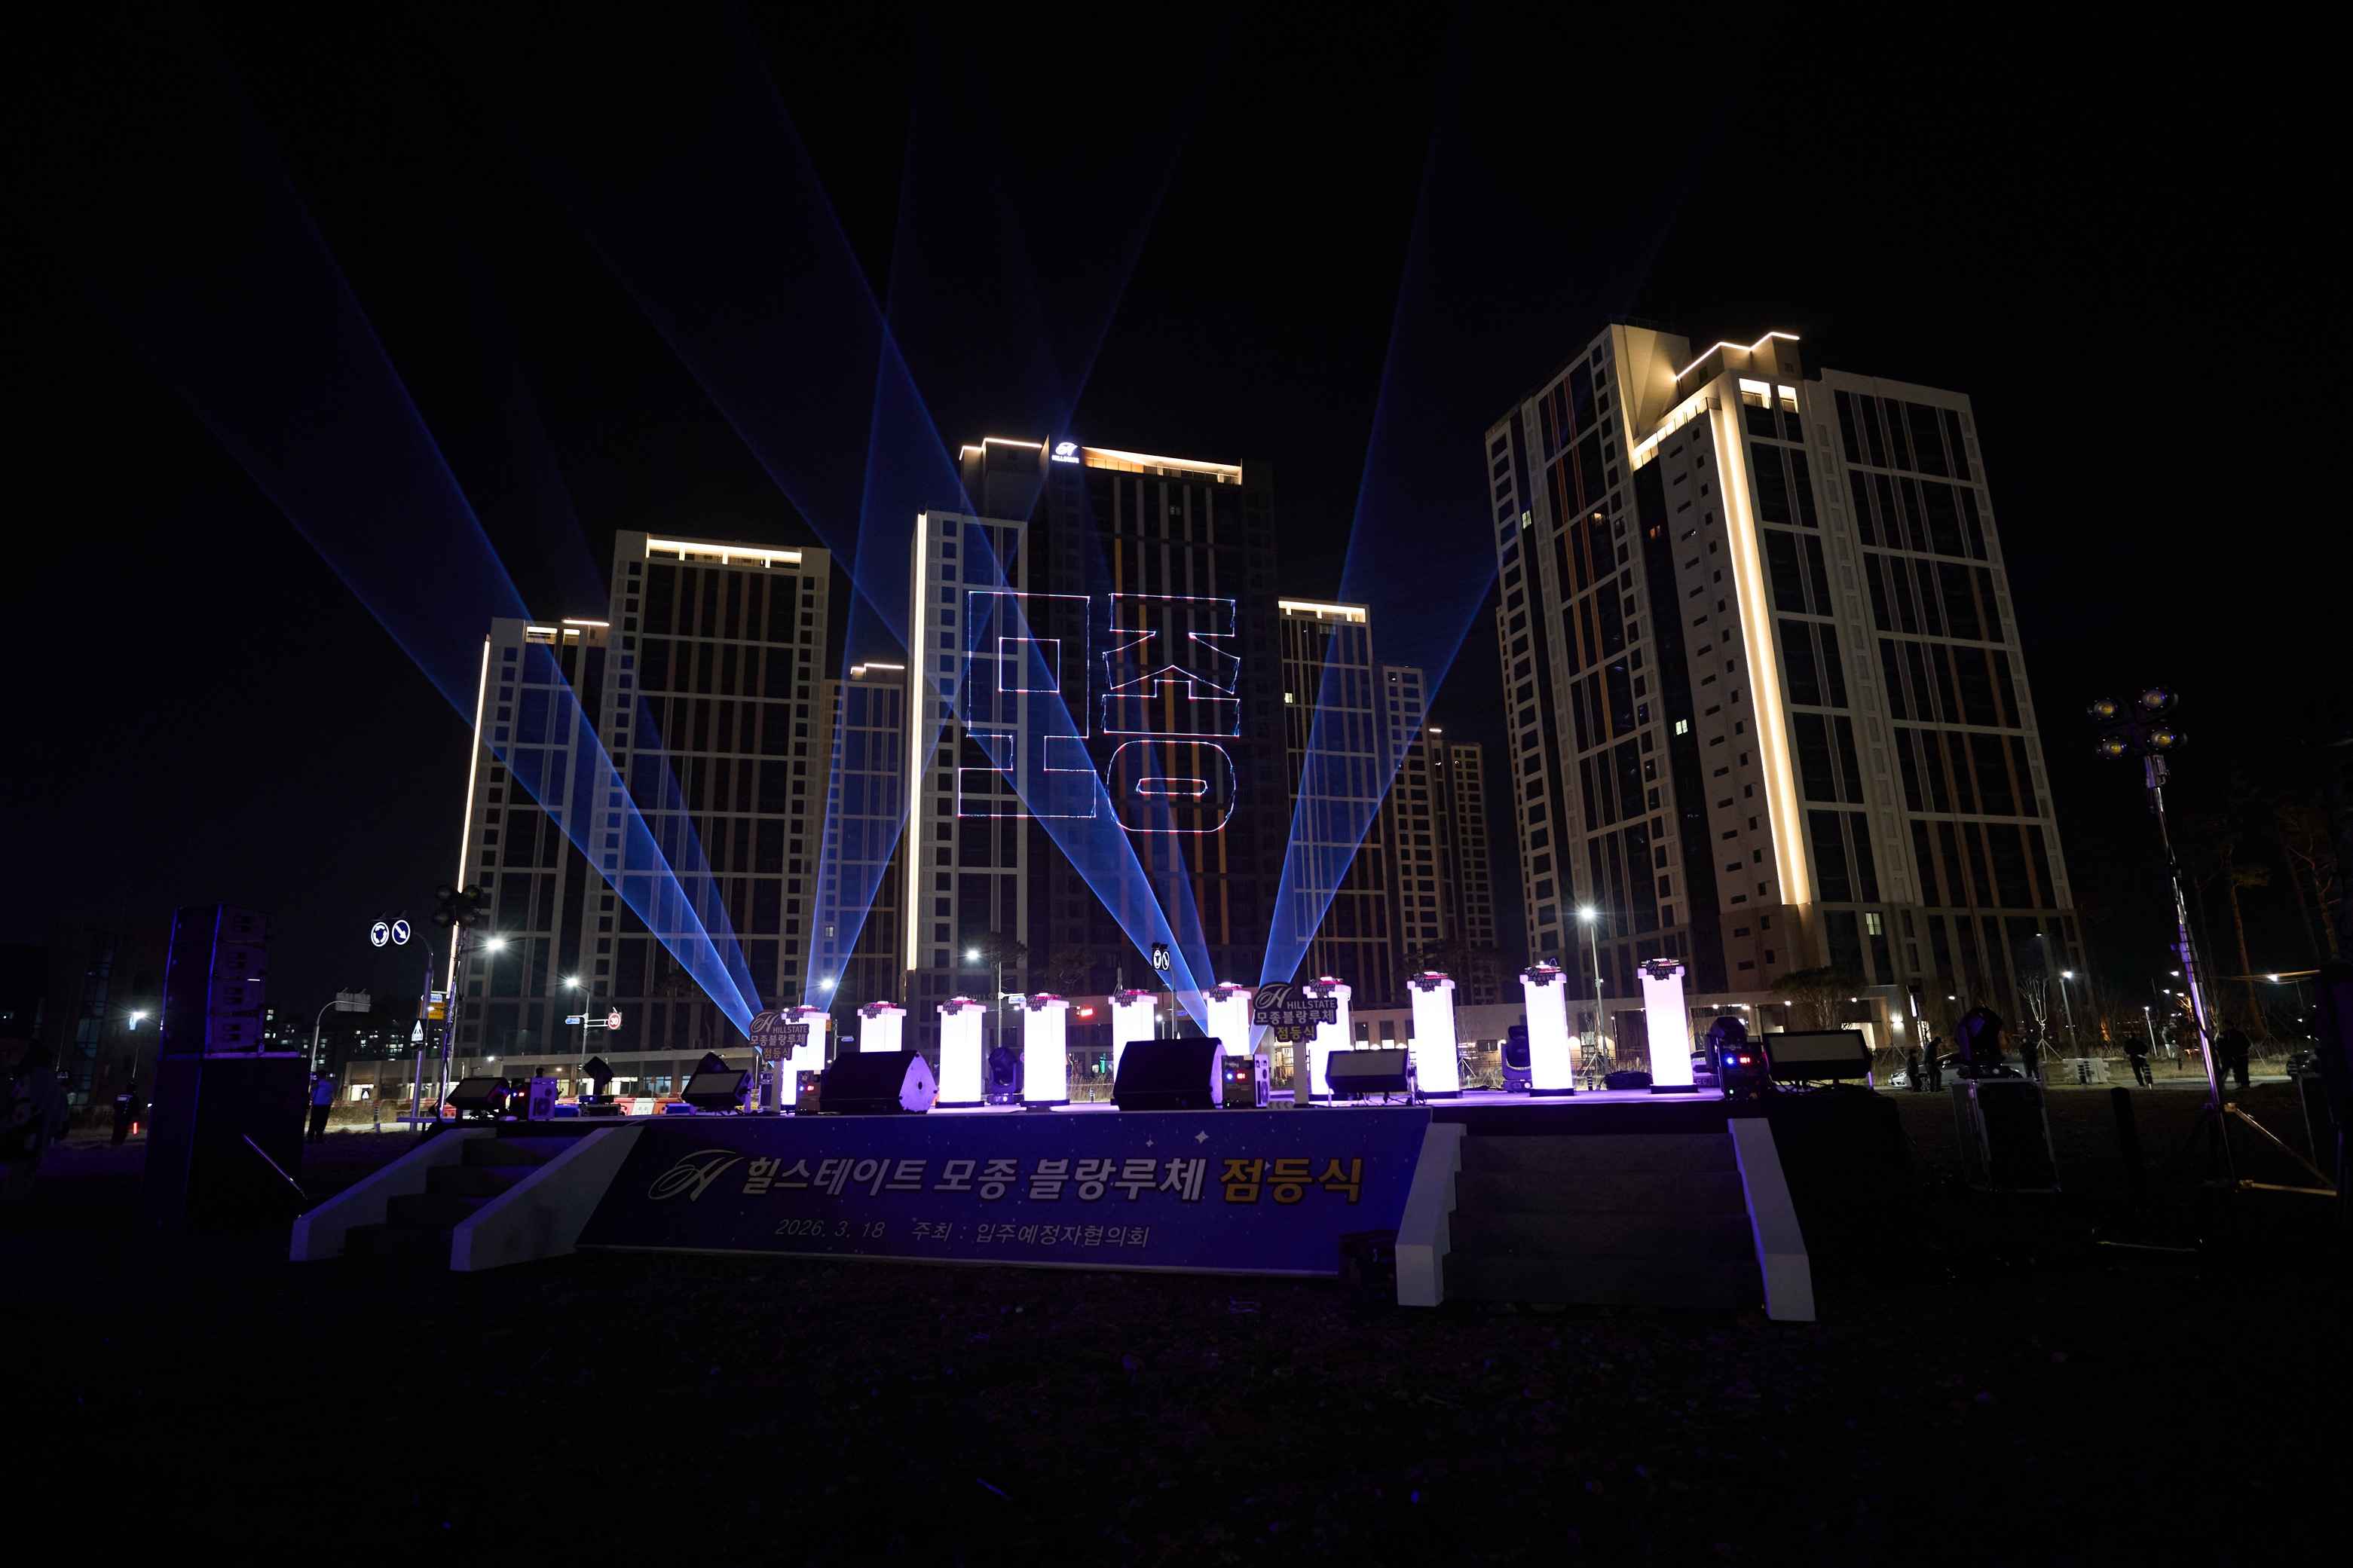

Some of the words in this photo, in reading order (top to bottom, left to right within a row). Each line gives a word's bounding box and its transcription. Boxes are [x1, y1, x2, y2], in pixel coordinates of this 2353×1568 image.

[1287, 999, 1336, 1010] HILLSTATE
[1256, 1010, 1335, 1025] 모종블랑루체
[773, 1025, 809, 1034] HILLSTATE
[1277, 1025, 1316, 1040] 점등식
[764, 1047, 791, 1059] 점등식
[742, 1157, 928, 1197] 힐스테이트
[933, 1158, 1017, 1200] 모종
[1029, 1157, 1206, 1201] 블랑루체
[1219, 1157, 1362, 1203] 점등식
[775, 1218, 826, 1237] 2026.
[834, 1219, 851, 1238] 3.
[861, 1221, 886, 1238] 18
[911, 1221, 953, 1242] 주최
[976, 1222, 1151, 1248] 입주예정자협의회
